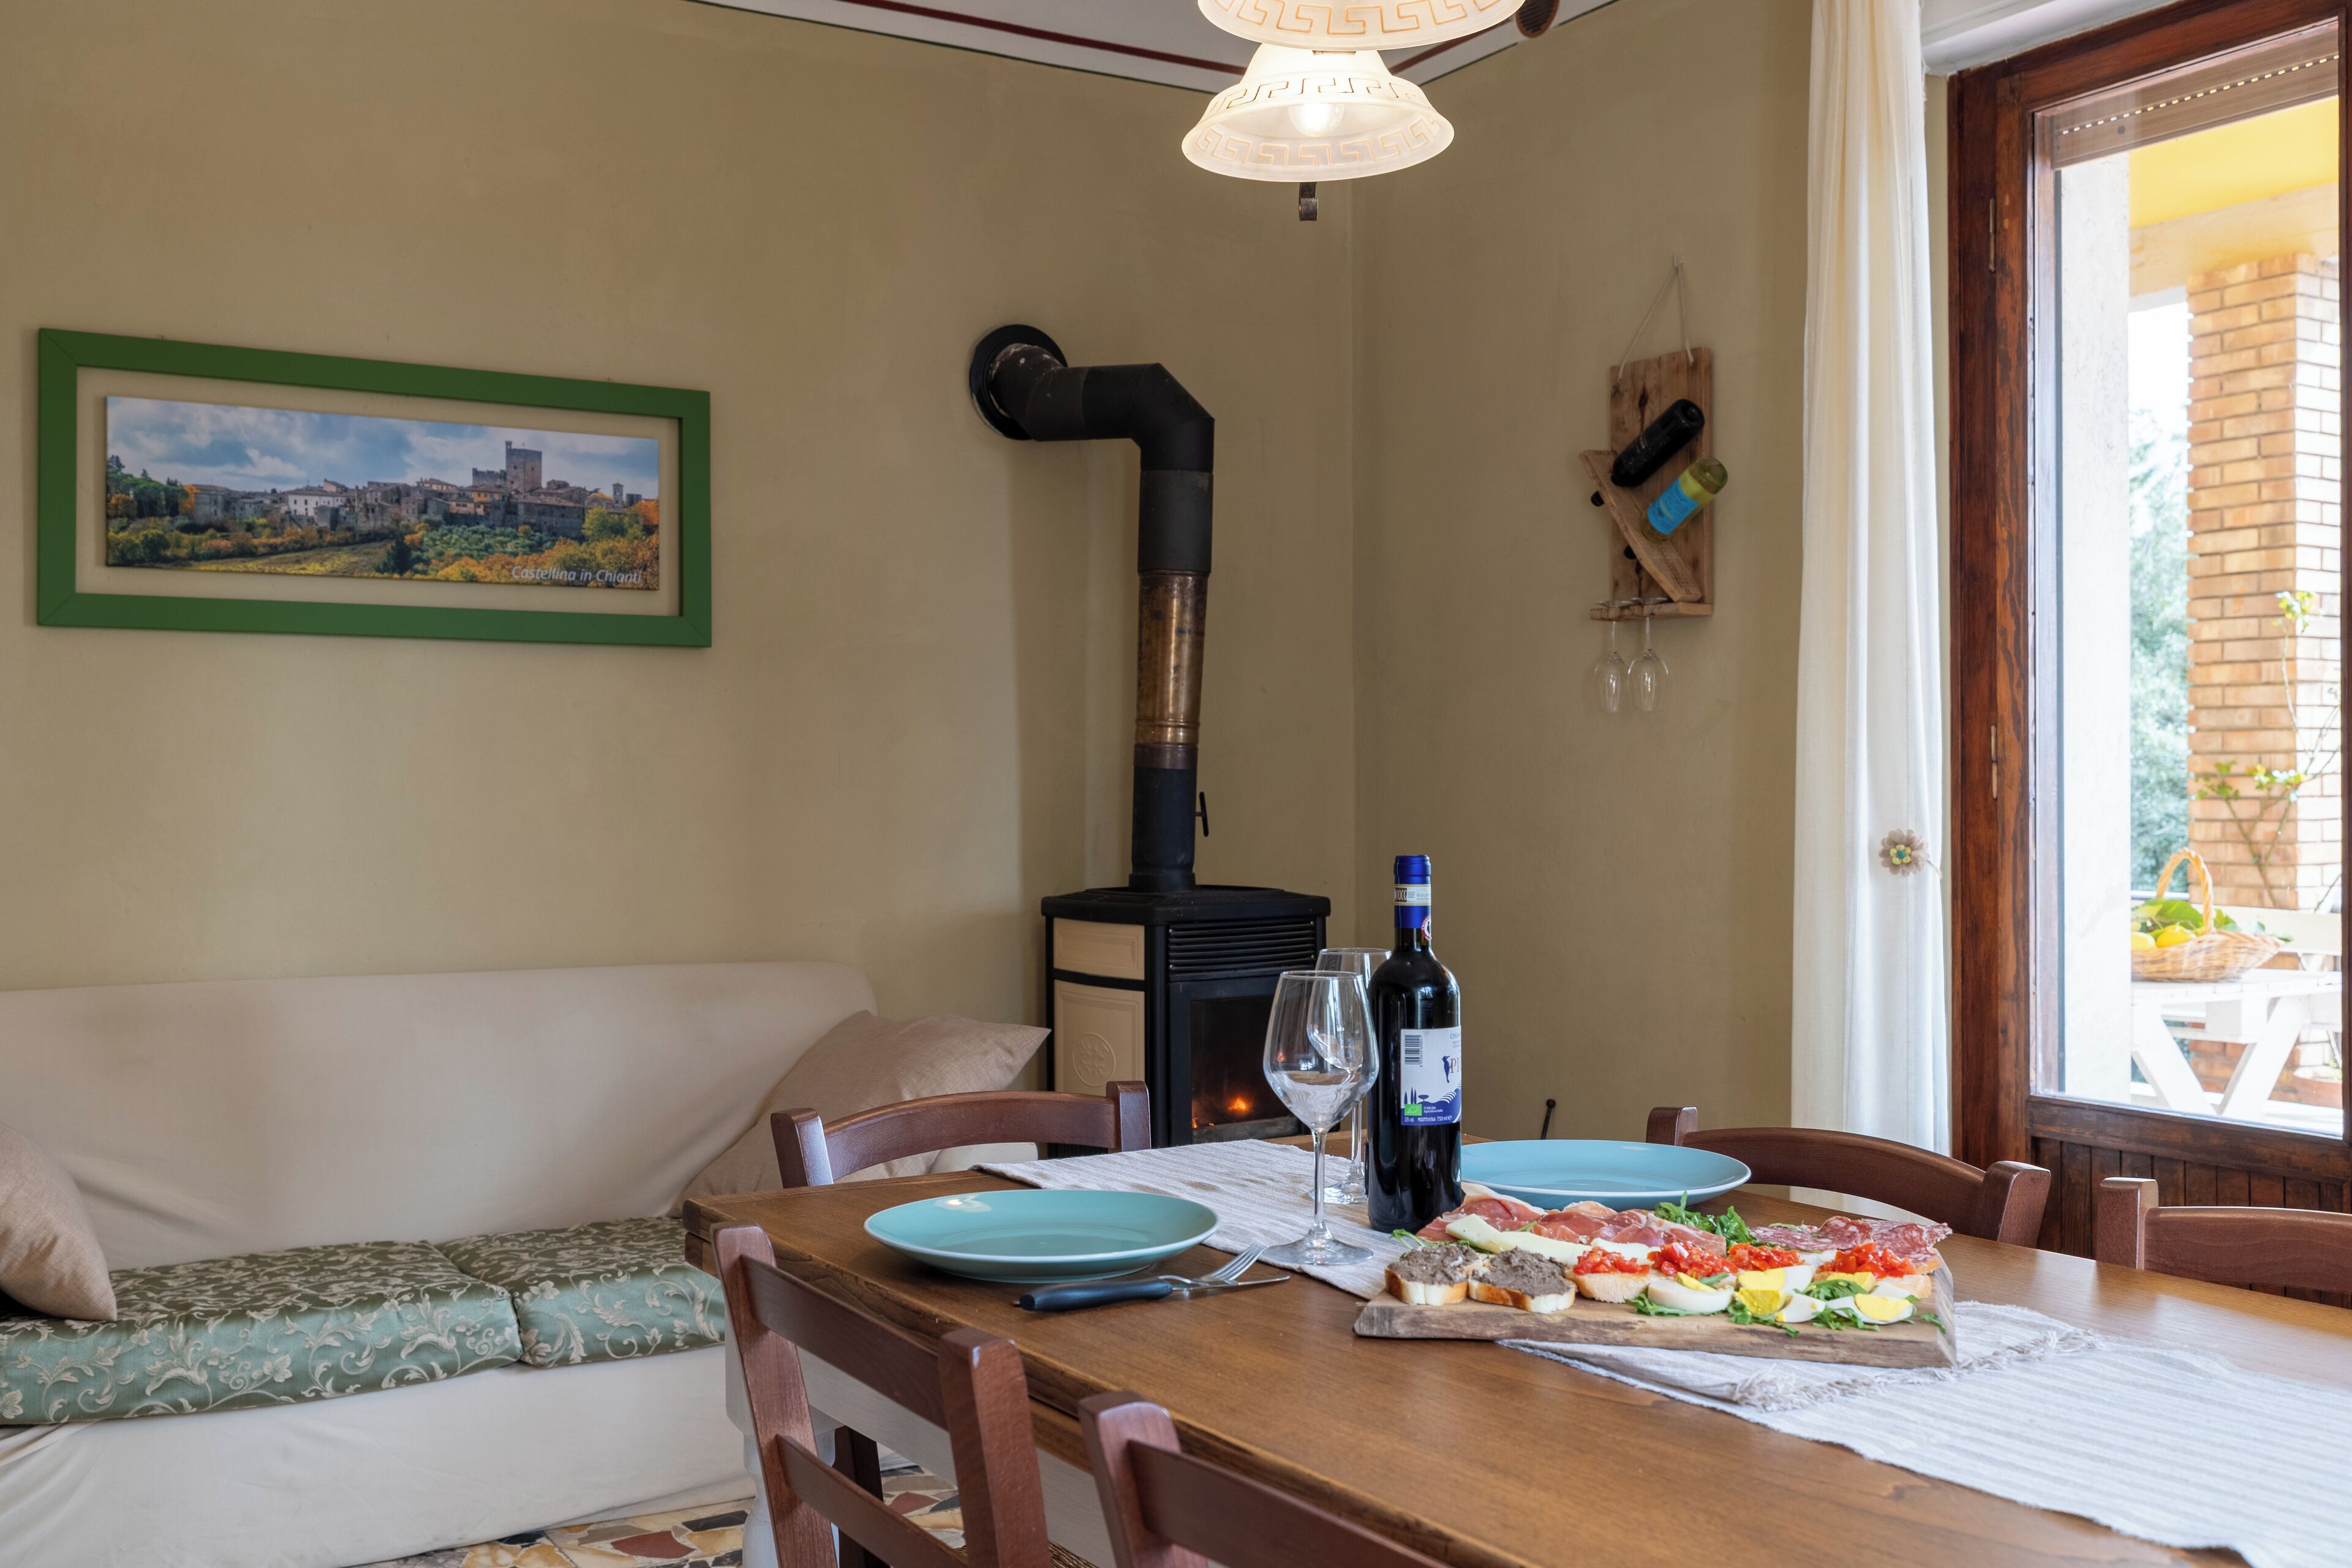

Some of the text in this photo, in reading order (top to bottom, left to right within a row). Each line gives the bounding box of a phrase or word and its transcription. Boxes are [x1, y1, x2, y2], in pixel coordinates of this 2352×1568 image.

[512, 565, 641, 583] Castellina in Chianti
